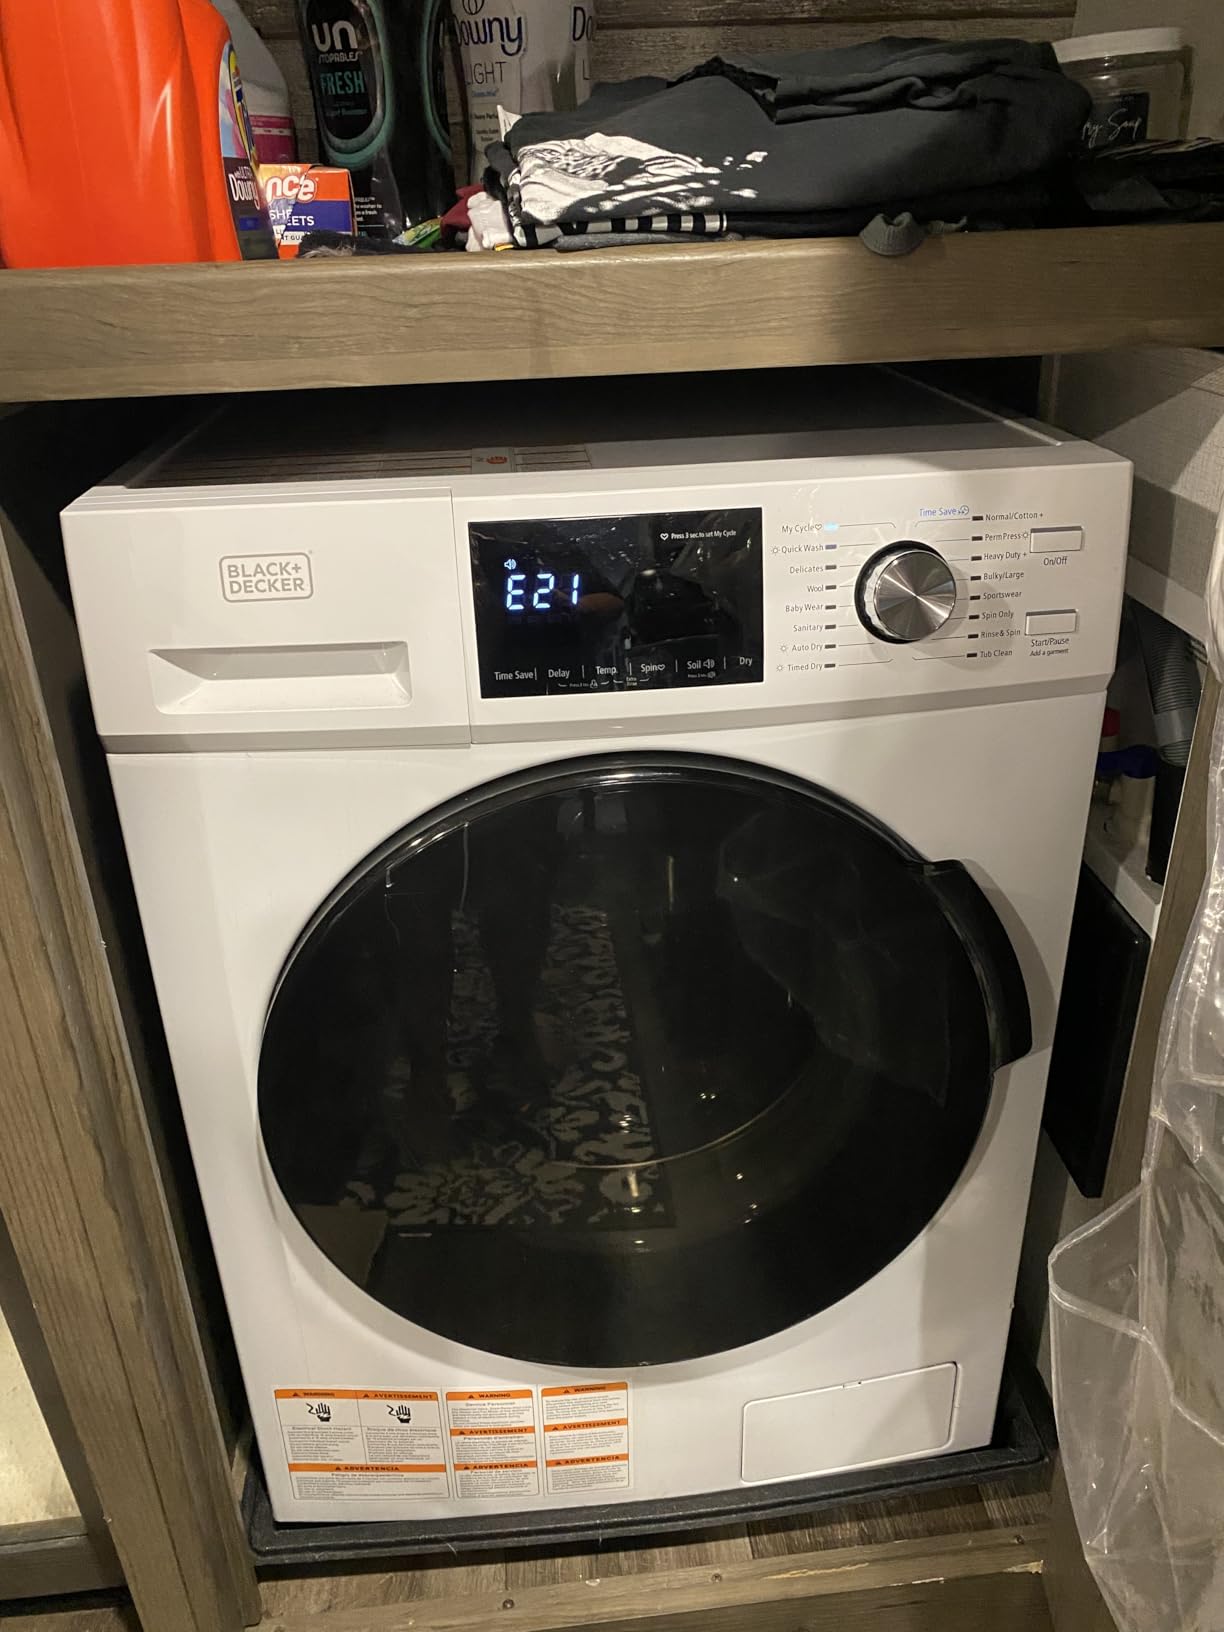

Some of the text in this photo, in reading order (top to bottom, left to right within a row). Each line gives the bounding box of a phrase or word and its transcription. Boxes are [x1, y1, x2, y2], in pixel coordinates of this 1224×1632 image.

[320, 71, 366, 95] FRESH
[228, 173, 261, 210] Downy
[919, 507, 957, 517] Time Save
[985, 511, 1038, 521] Normal/Cotton
[714, 530, 722, 538] My
[723, 529, 737, 538] Cycle
[782, 523, 815, 535] My Cycle
[782, 543, 824, 554] Quick Wash
[983, 552, 1004, 561] Heavy
[1005, 551, 1021, 560] Duty
[1043, 556, 1068, 566] On/Off
[227, 561, 302, 578] BLACK+
[789, 565, 824, 574] Delicates
[983, 570, 1025, 581] Bulky/Large
[229, 577, 305, 594] DECKER
[806, 584, 824, 593] Wool
[506, 573, 580, 611] E21
[983, 591, 1022, 600] Sportswear
[785, 603, 824, 614] Baby Wear
[981, 610, 1014, 620] Spin Only
[793, 624, 824, 633] Sanitary
[1005, 628, 1021, 637] Spin
[1031, 637, 1070, 648] Start/Pause
[791, 643, 824, 653] Auto Dry
[1029, 649, 1042, 657] Add
[980, 649, 1013, 658] Tub Clean
[686, 659, 702, 670] Soil
[739, 656, 753, 667] Dry
[640, 663, 657, 674] Spin
[787, 662, 823, 672] Timed Dry
[494, 670, 534, 681] Time Save
[547, 668, 570, 679] Delay
[562, 1420, 622, 1430] AVERTISSEMENT
[564, 1455, 621, 1465] ADVERTENCIA
